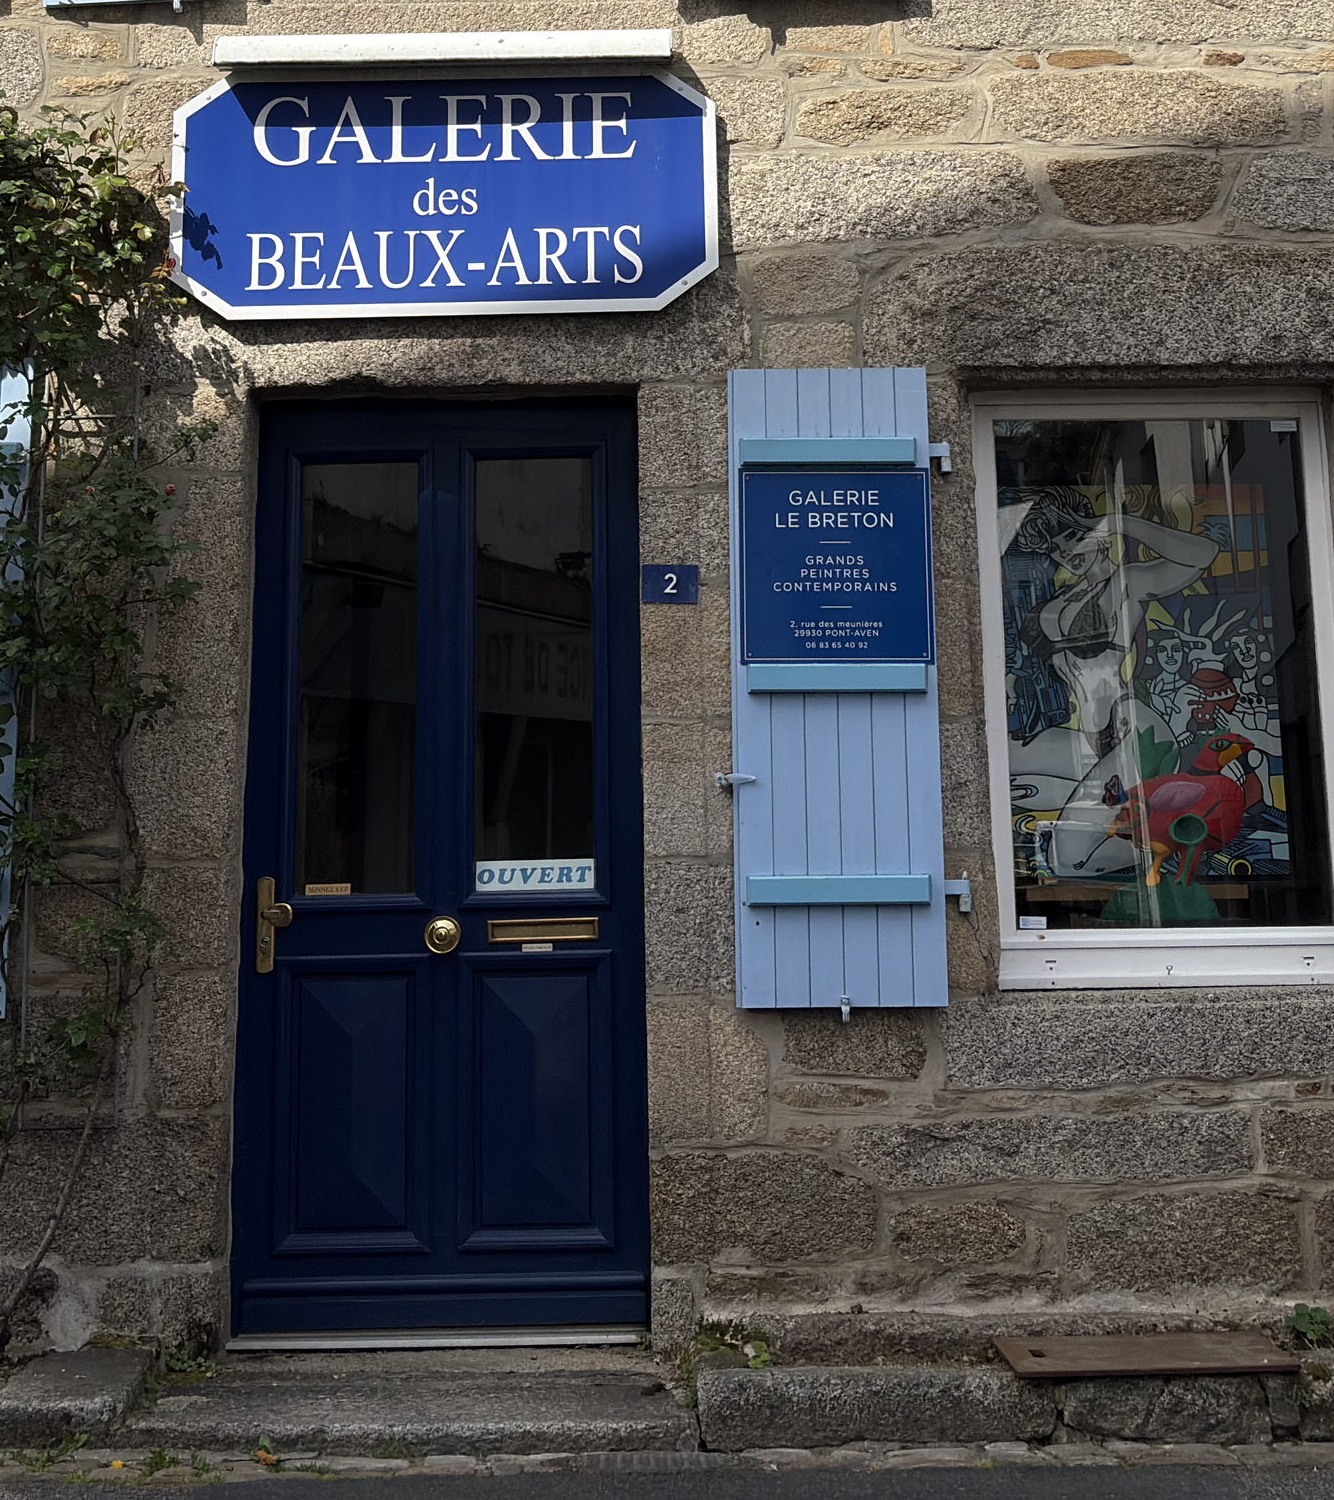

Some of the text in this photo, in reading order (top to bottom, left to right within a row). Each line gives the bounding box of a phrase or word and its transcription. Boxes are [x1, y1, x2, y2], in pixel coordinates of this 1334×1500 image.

[253, 92, 638, 166] GALERIE
[412, 177, 479, 217] des
[244, 224, 644, 291] BEAUX-ARTS
[788, 490, 880, 506] GALERIE
[775, 512, 894, 528] LE BRETON
[805, 555, 865, 566] GRANDS
[800, 568, 870, 579] PEINTRES
[663, 573, 678, 594] 2
[773, 581, 898, 592] CONTEMPORAINS
[818, 620, 835, 628] des
[794, 629, 879, 637] 29930 PONT-AVEN
[805, 641, 869, 649] 06 83 65 40 92
[477, 864, 593, 886] OUVERT
